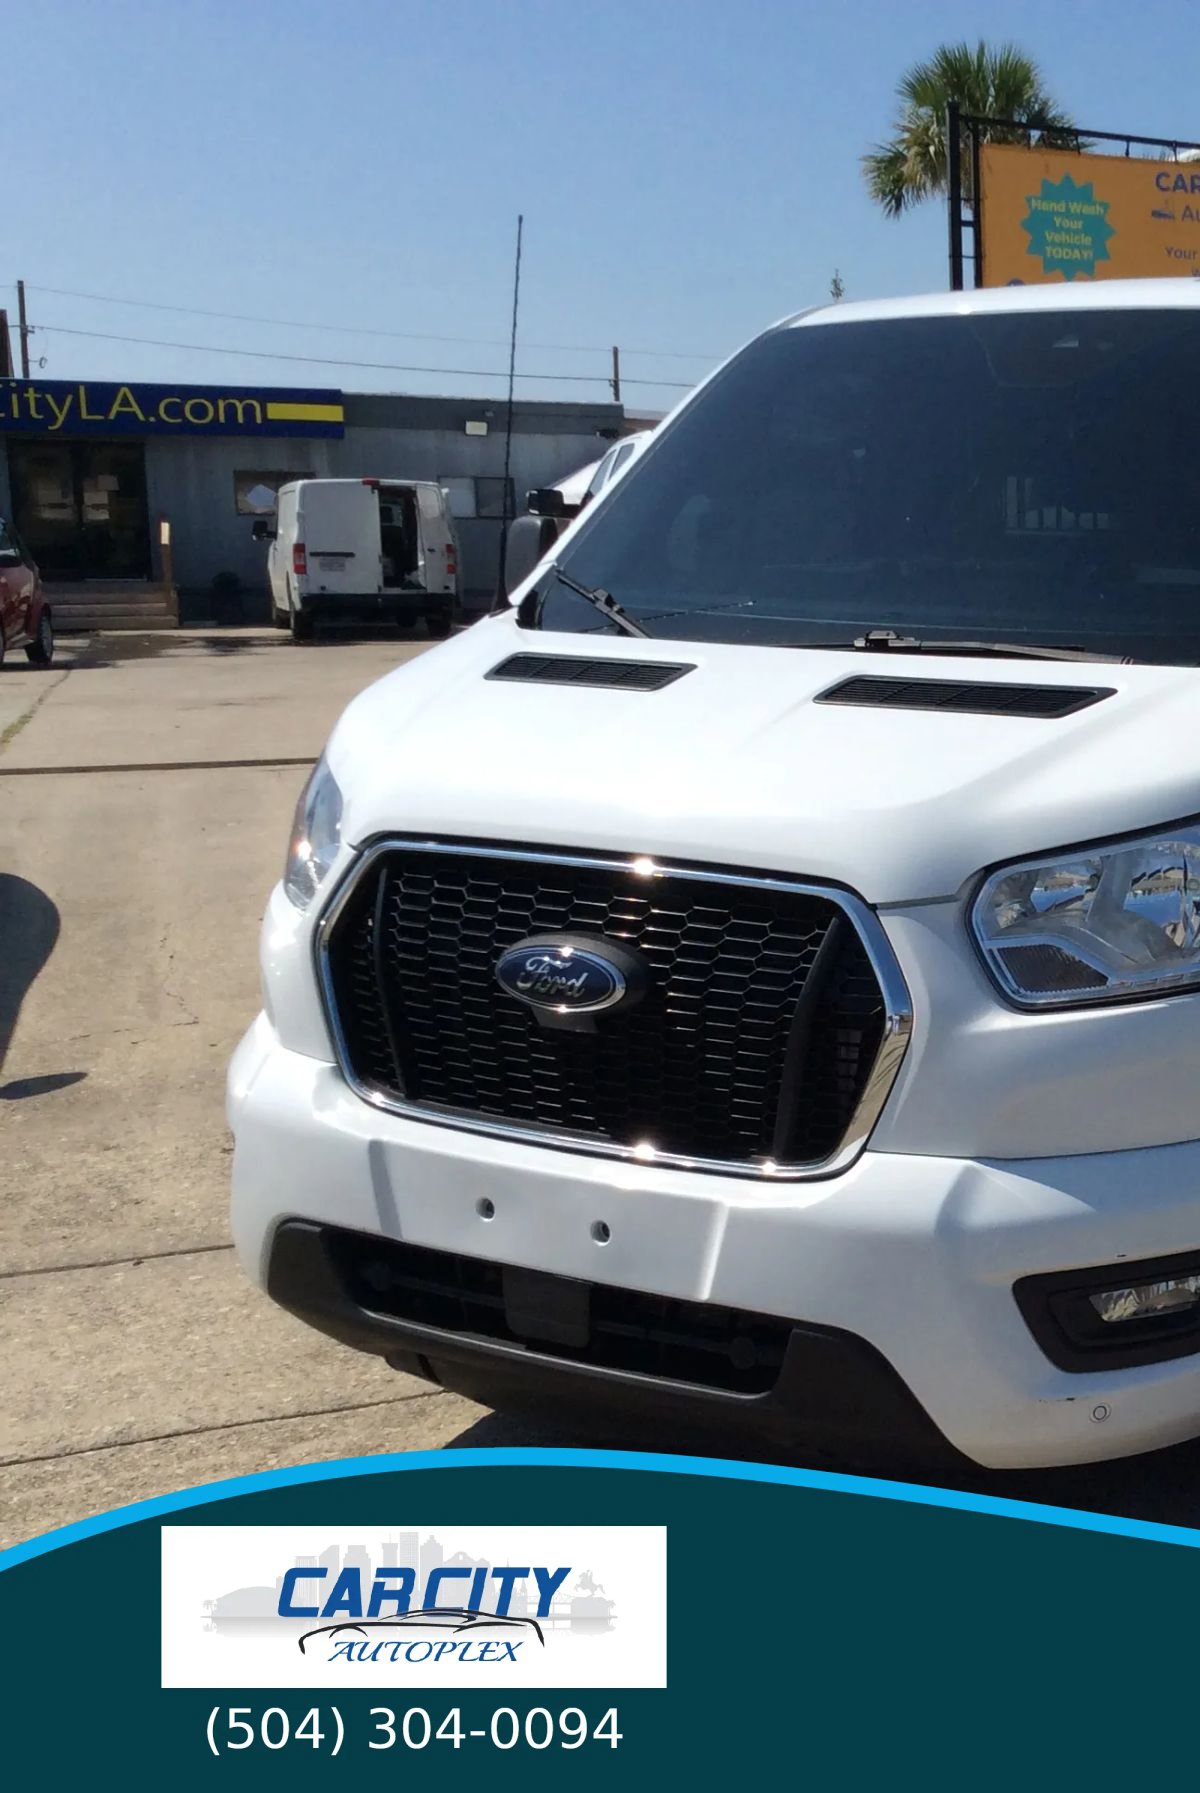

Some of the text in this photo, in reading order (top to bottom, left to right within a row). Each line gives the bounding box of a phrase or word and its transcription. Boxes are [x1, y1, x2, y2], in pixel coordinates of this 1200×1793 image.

[1069, 201, 1105, 217] Wash
[1054, 216, 1084, 230] Your
[1045, 231, 1092, 246] Vehicle
[1165, 246, 1197, 261] Your
[0, 382, 263, 431] ityLA.com
[516, 956, 589, 998] Ford
